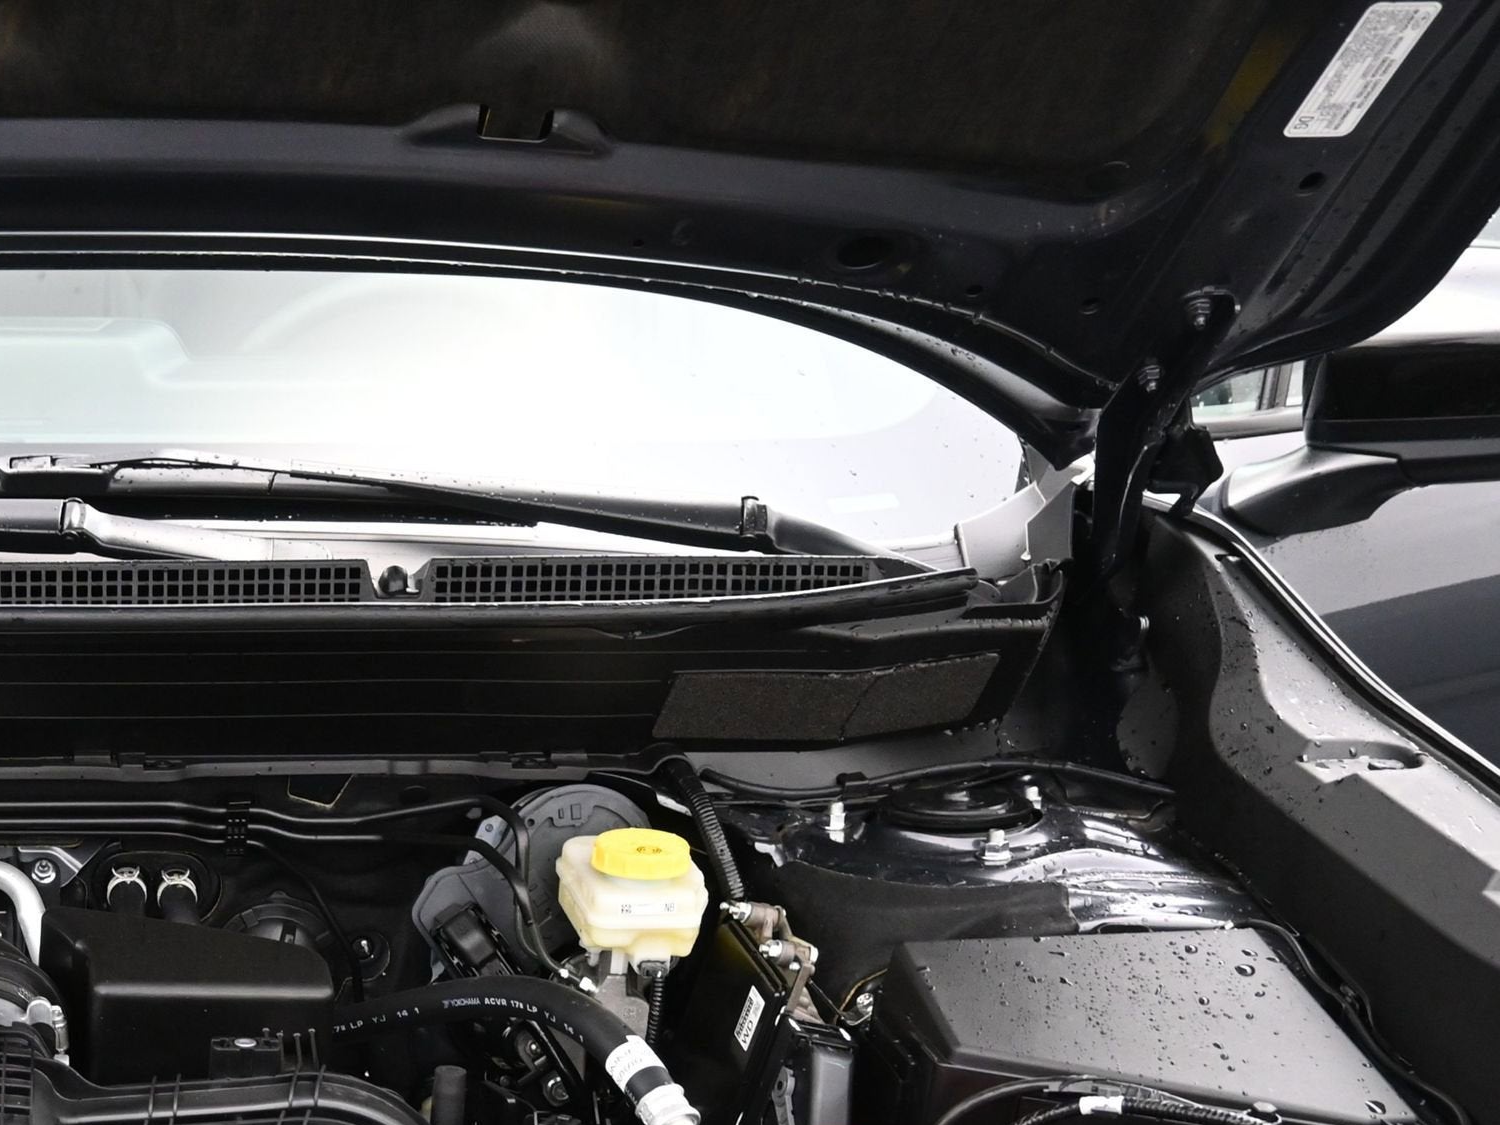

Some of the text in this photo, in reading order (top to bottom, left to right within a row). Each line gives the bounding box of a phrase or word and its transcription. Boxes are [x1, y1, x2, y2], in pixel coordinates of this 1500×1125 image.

[484, 997, 508, 1006] ACVR
[527, 1004, 538, 1013] LP
[544, 1010, 556, 1023] YJ
[349, 1020, 364, 1030] LP
[372, 1014, 387, 1024] YJ
